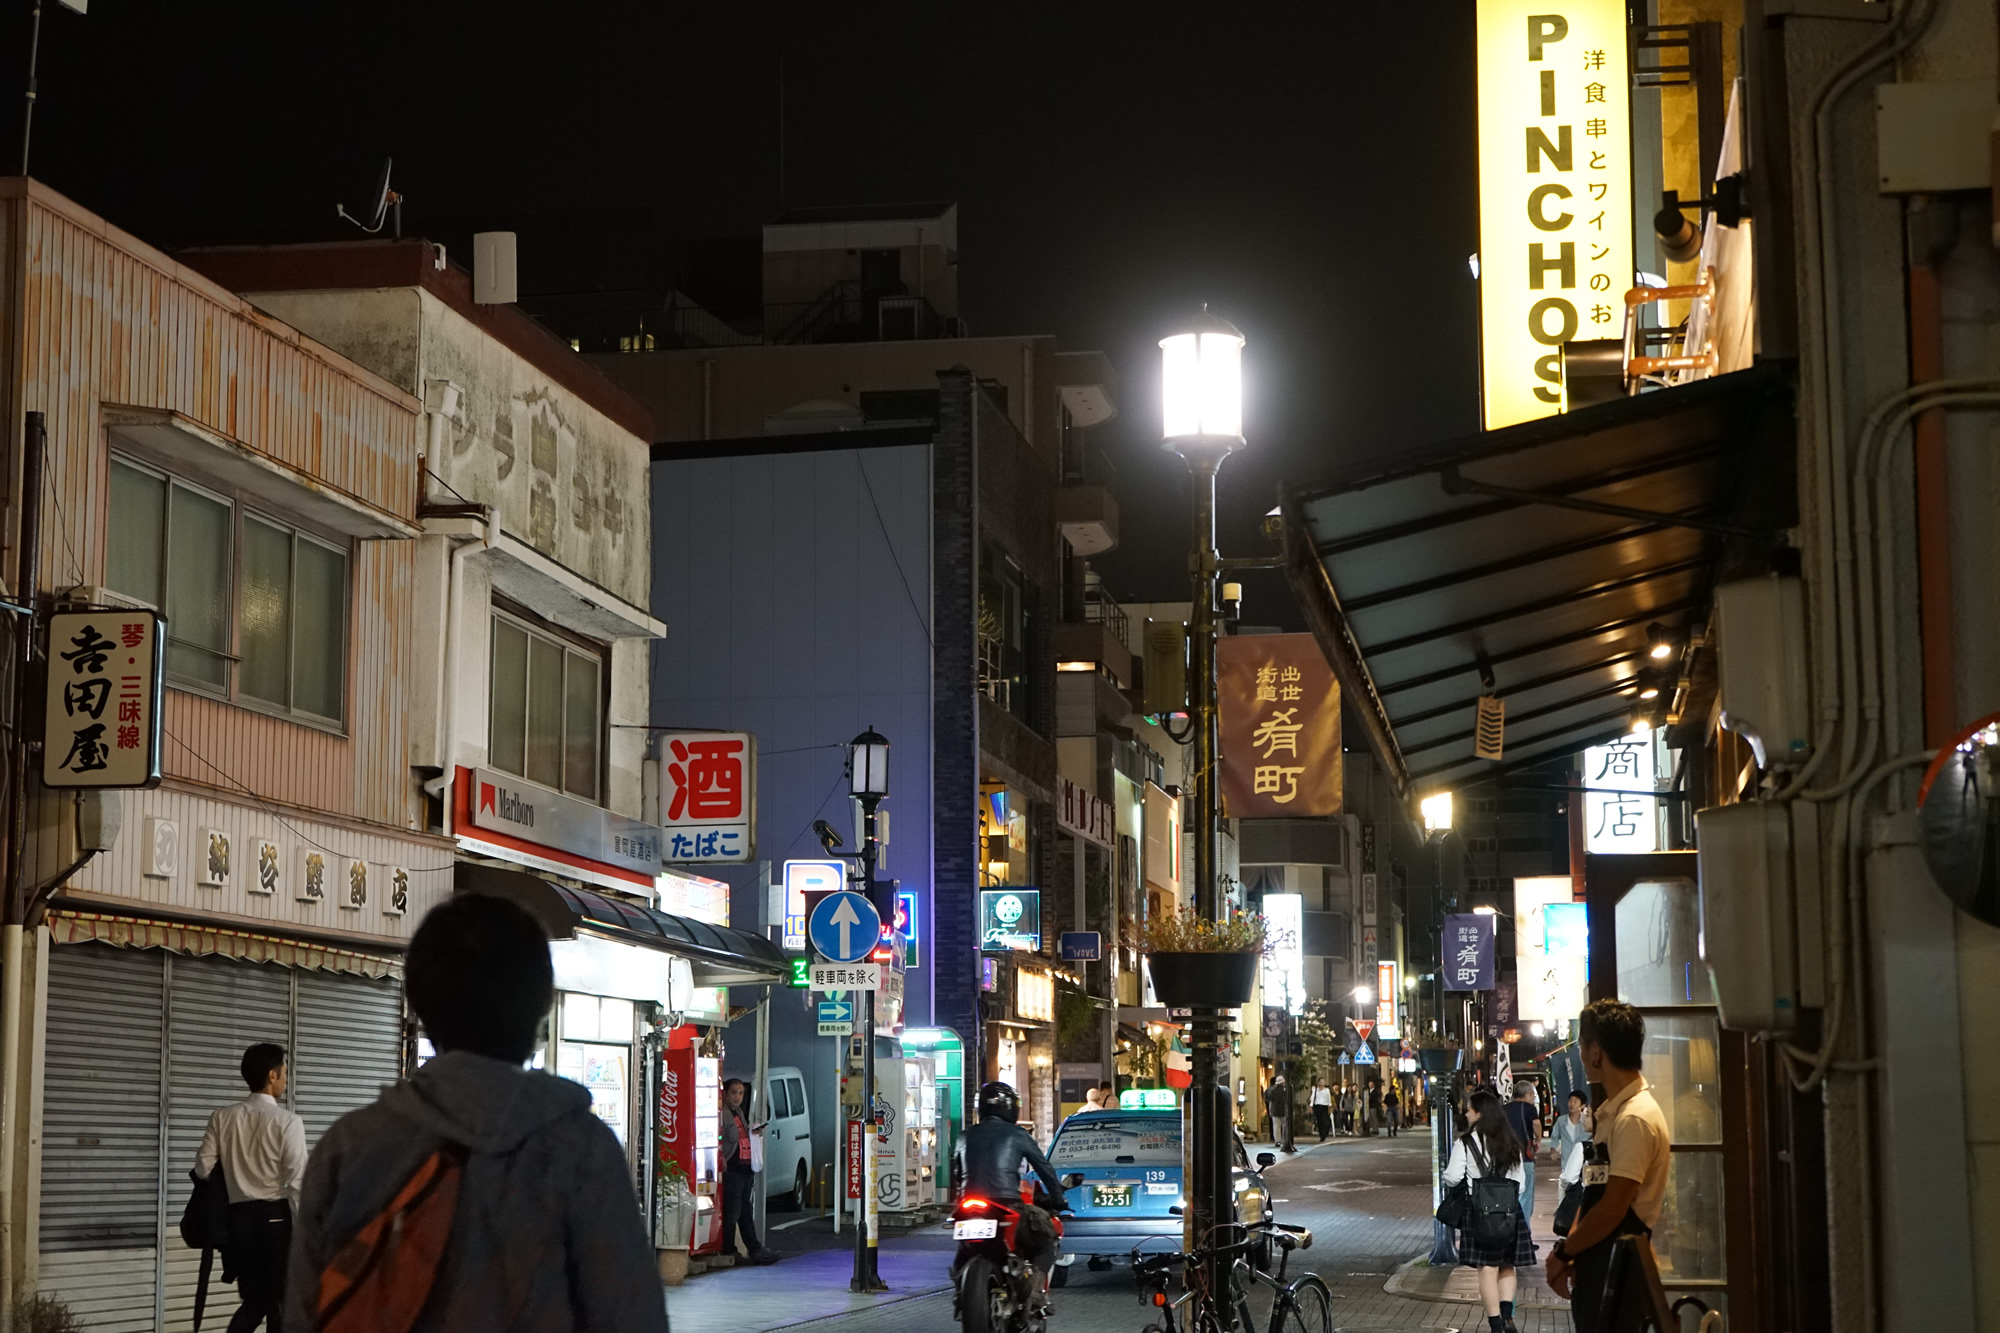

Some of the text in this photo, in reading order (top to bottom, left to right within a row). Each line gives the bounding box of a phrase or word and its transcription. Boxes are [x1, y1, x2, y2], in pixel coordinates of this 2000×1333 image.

[1583, 49, 1612, 339] 洋食串とワインのお
[58, 624, 117, 774] 吉田屋
[117, 624, 145, 750] 琴・三味線
[1255, 667, 1279, 702] 街道
[1279, 666, 1303, 701] 出世
[1252, 707, 1306, 804] 肴町
[667, 739, 744, 821] 酒
[1593, 738, 1649, 839] 商店
[498, 787, 534, 828] Marlboro
[670, 830, 741, 858] たばこ
[815, 969, 876, 985] 軽車両を除く
[1456, 944, 1480, 985] 肴町
[1145, 1171, 1166, 1181] 139
[1100, 1194, 1130, 1206] 32-51
